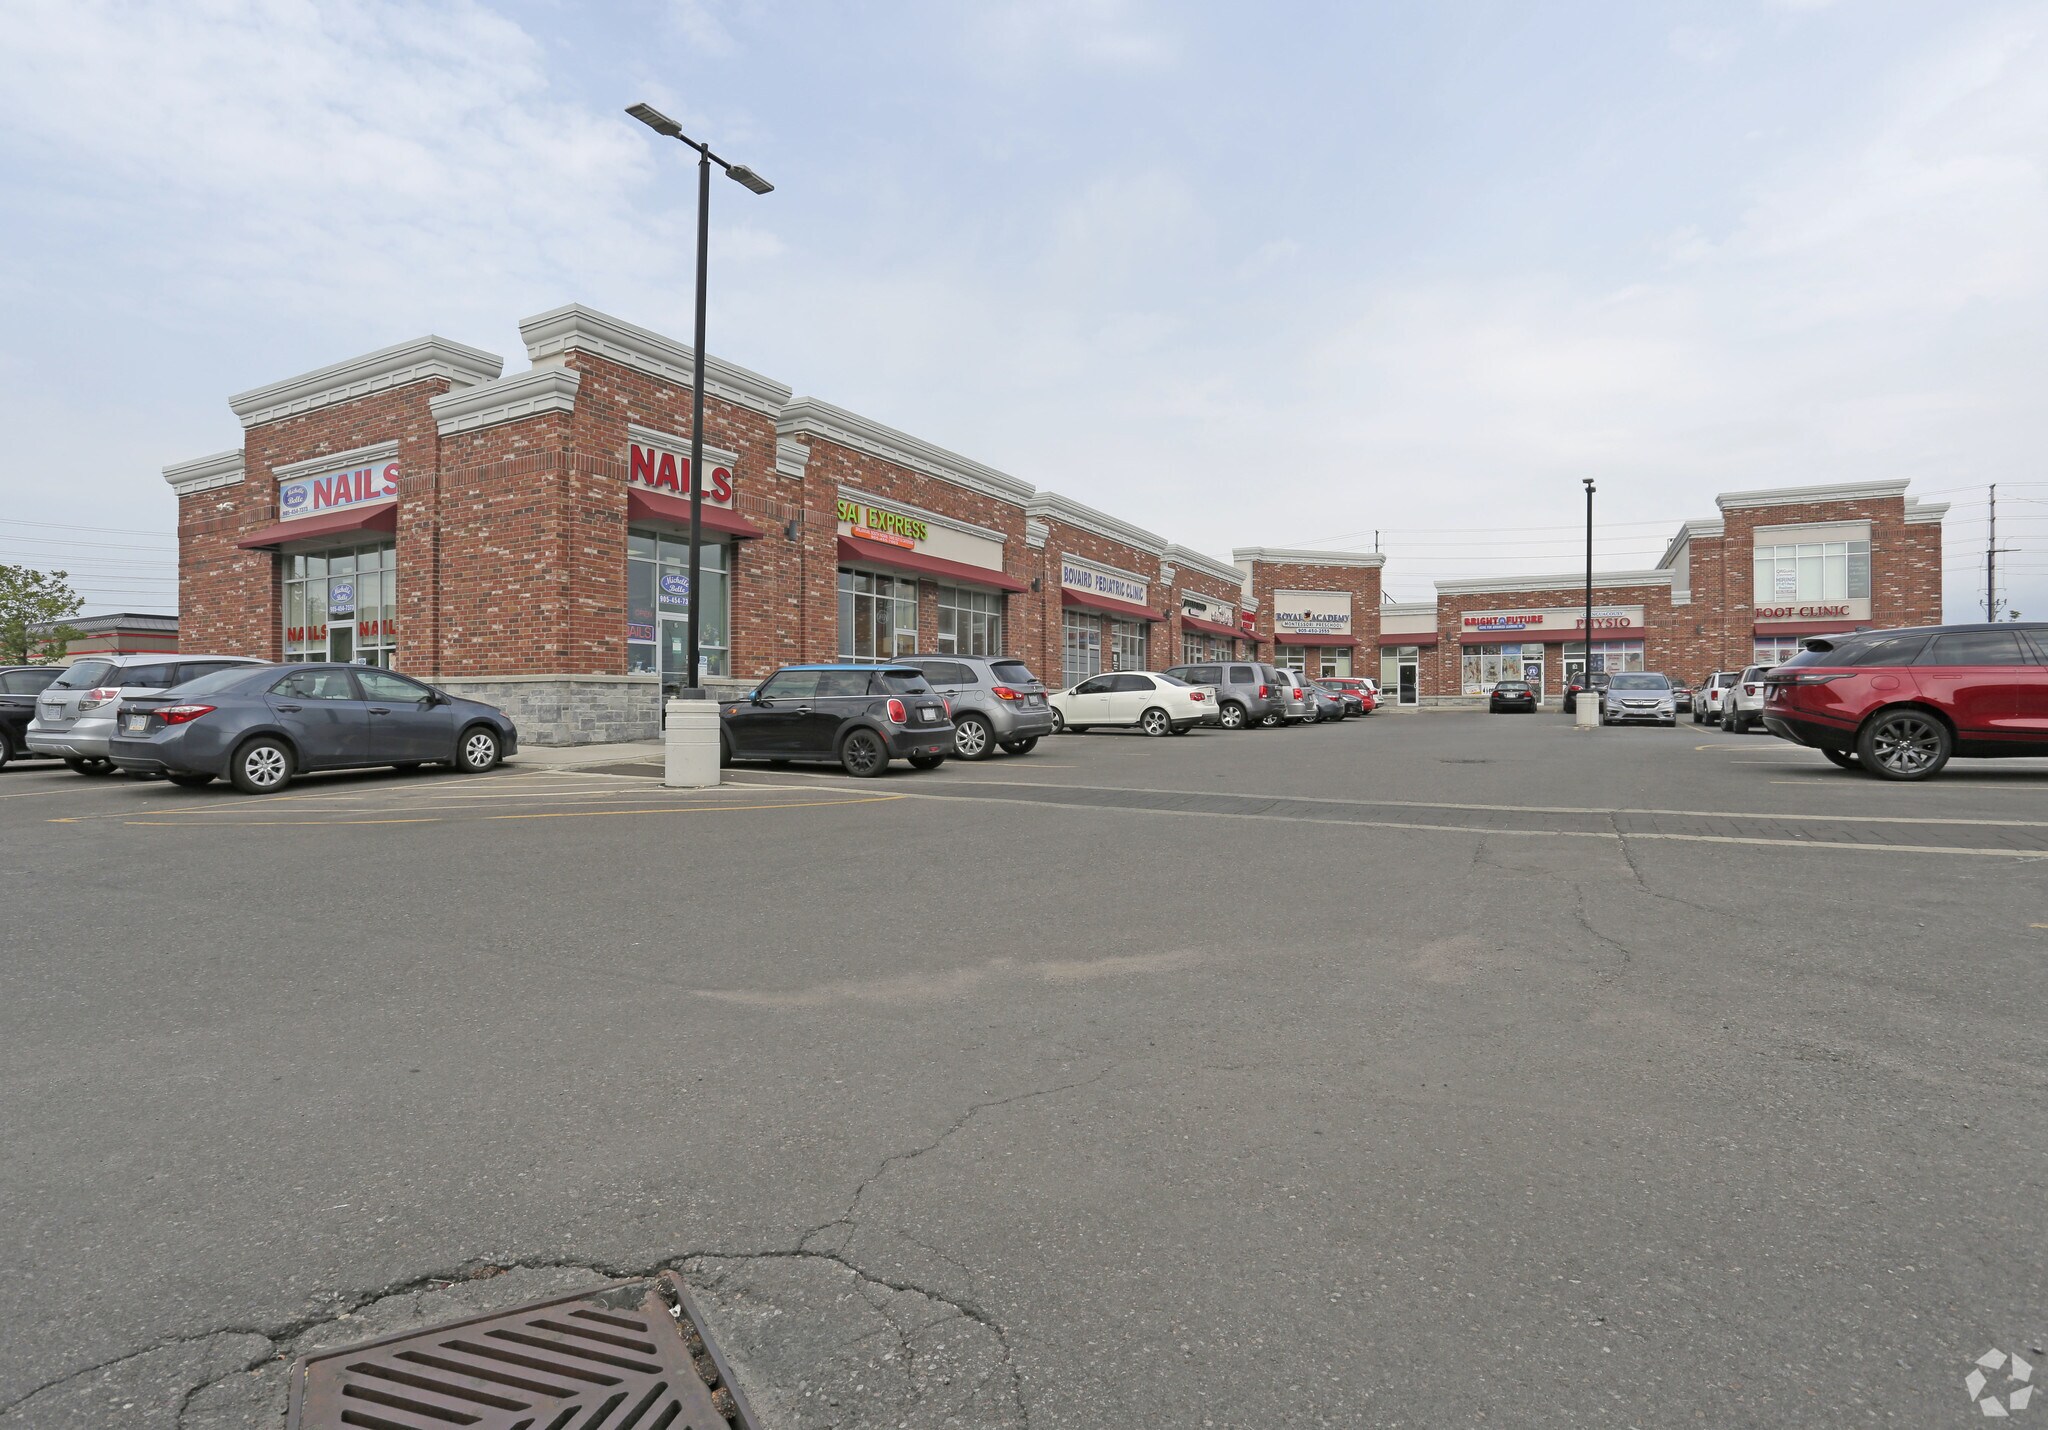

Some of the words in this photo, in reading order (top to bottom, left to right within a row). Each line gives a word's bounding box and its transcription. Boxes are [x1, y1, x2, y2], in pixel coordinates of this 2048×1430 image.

[630, 443, 732, 502] NAIS
[313, 463, 399, 509] NAILS
[866, 507, 929, 541] EXPRESS
[665, 576, 690, 588] Michelle
[668, 584, 686, 593] Belle
[1063, 566, 1092, 588] BOVAIRD
[1095, 575, 1125, 597] PEDIATRIC
[1126, 583, 1144, 600] CLINIC
[659, 595, 689, 605] 905-454-73
[1275, 612, 1303, 621] ROYAL
[1311, 613, 1350, 623] ACADEMY
[1755, 607, 1795, 618] FOOT
[1800, 605, 1850, 617] CLINIC
[359, 619, 396, 637] NAIL
[1464, 616, 1499, 626] BRIGHT
[1506, 615, 1543, 625] FUTURE
[287, 625, 327, 642] NAILS
